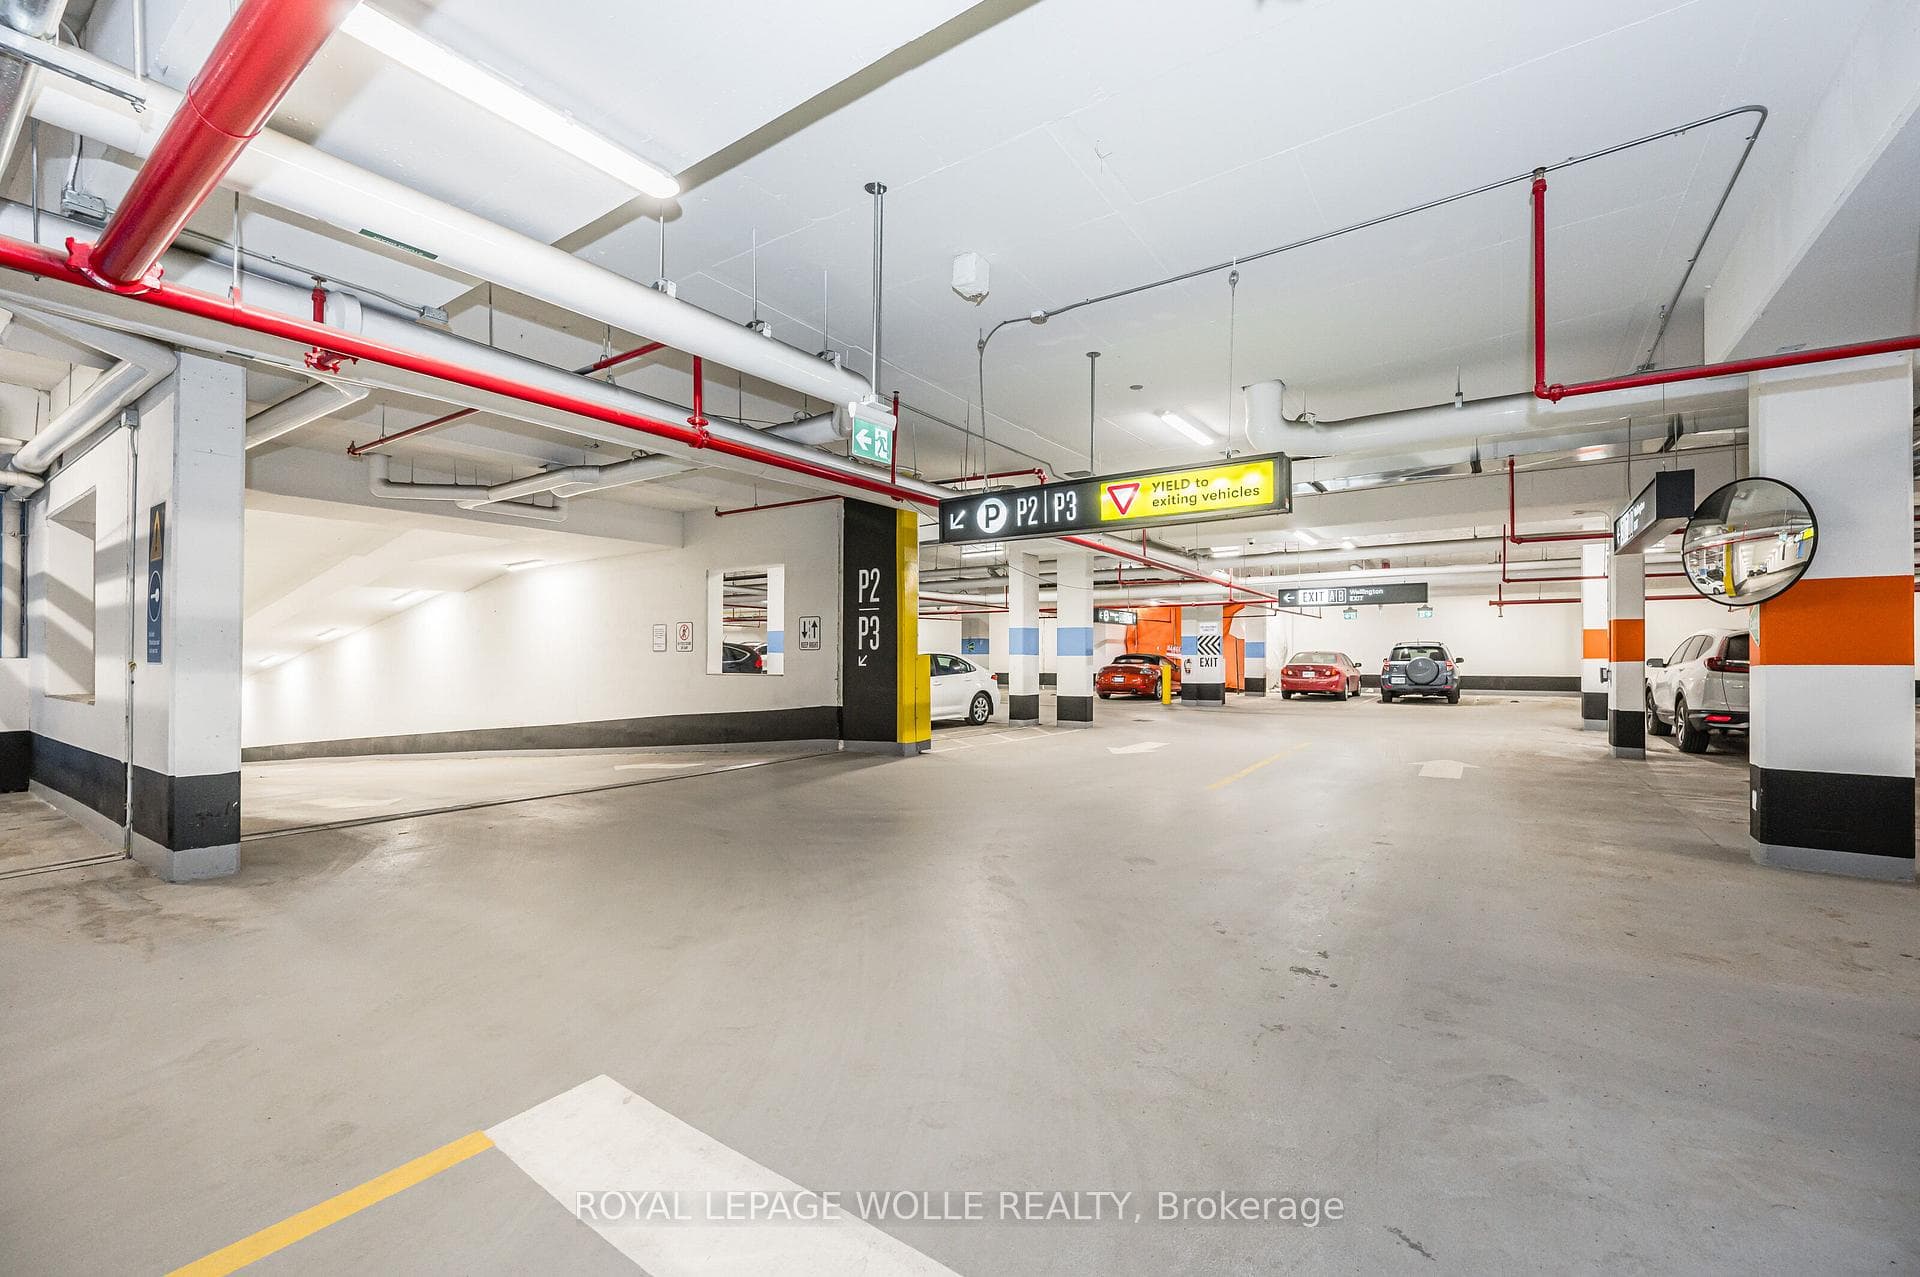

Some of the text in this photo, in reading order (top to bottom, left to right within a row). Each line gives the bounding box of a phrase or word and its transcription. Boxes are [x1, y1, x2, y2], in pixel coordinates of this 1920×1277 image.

[1152, 478, 1208, 492] YIELD to
[1152, 486, 1260, 506] exiting vehicles
[985, 491, 1077, 528] P P2 P3
[858, 568, 880, 603] P2
[1350, 588, 1384, 596] Wellington
[1303, 591, 1324, 602] EXIT
[1329, 589, 1336, 602] A
[858, 615, 880, 650] P3
[1199, 657, 1218, 668] EXIT
